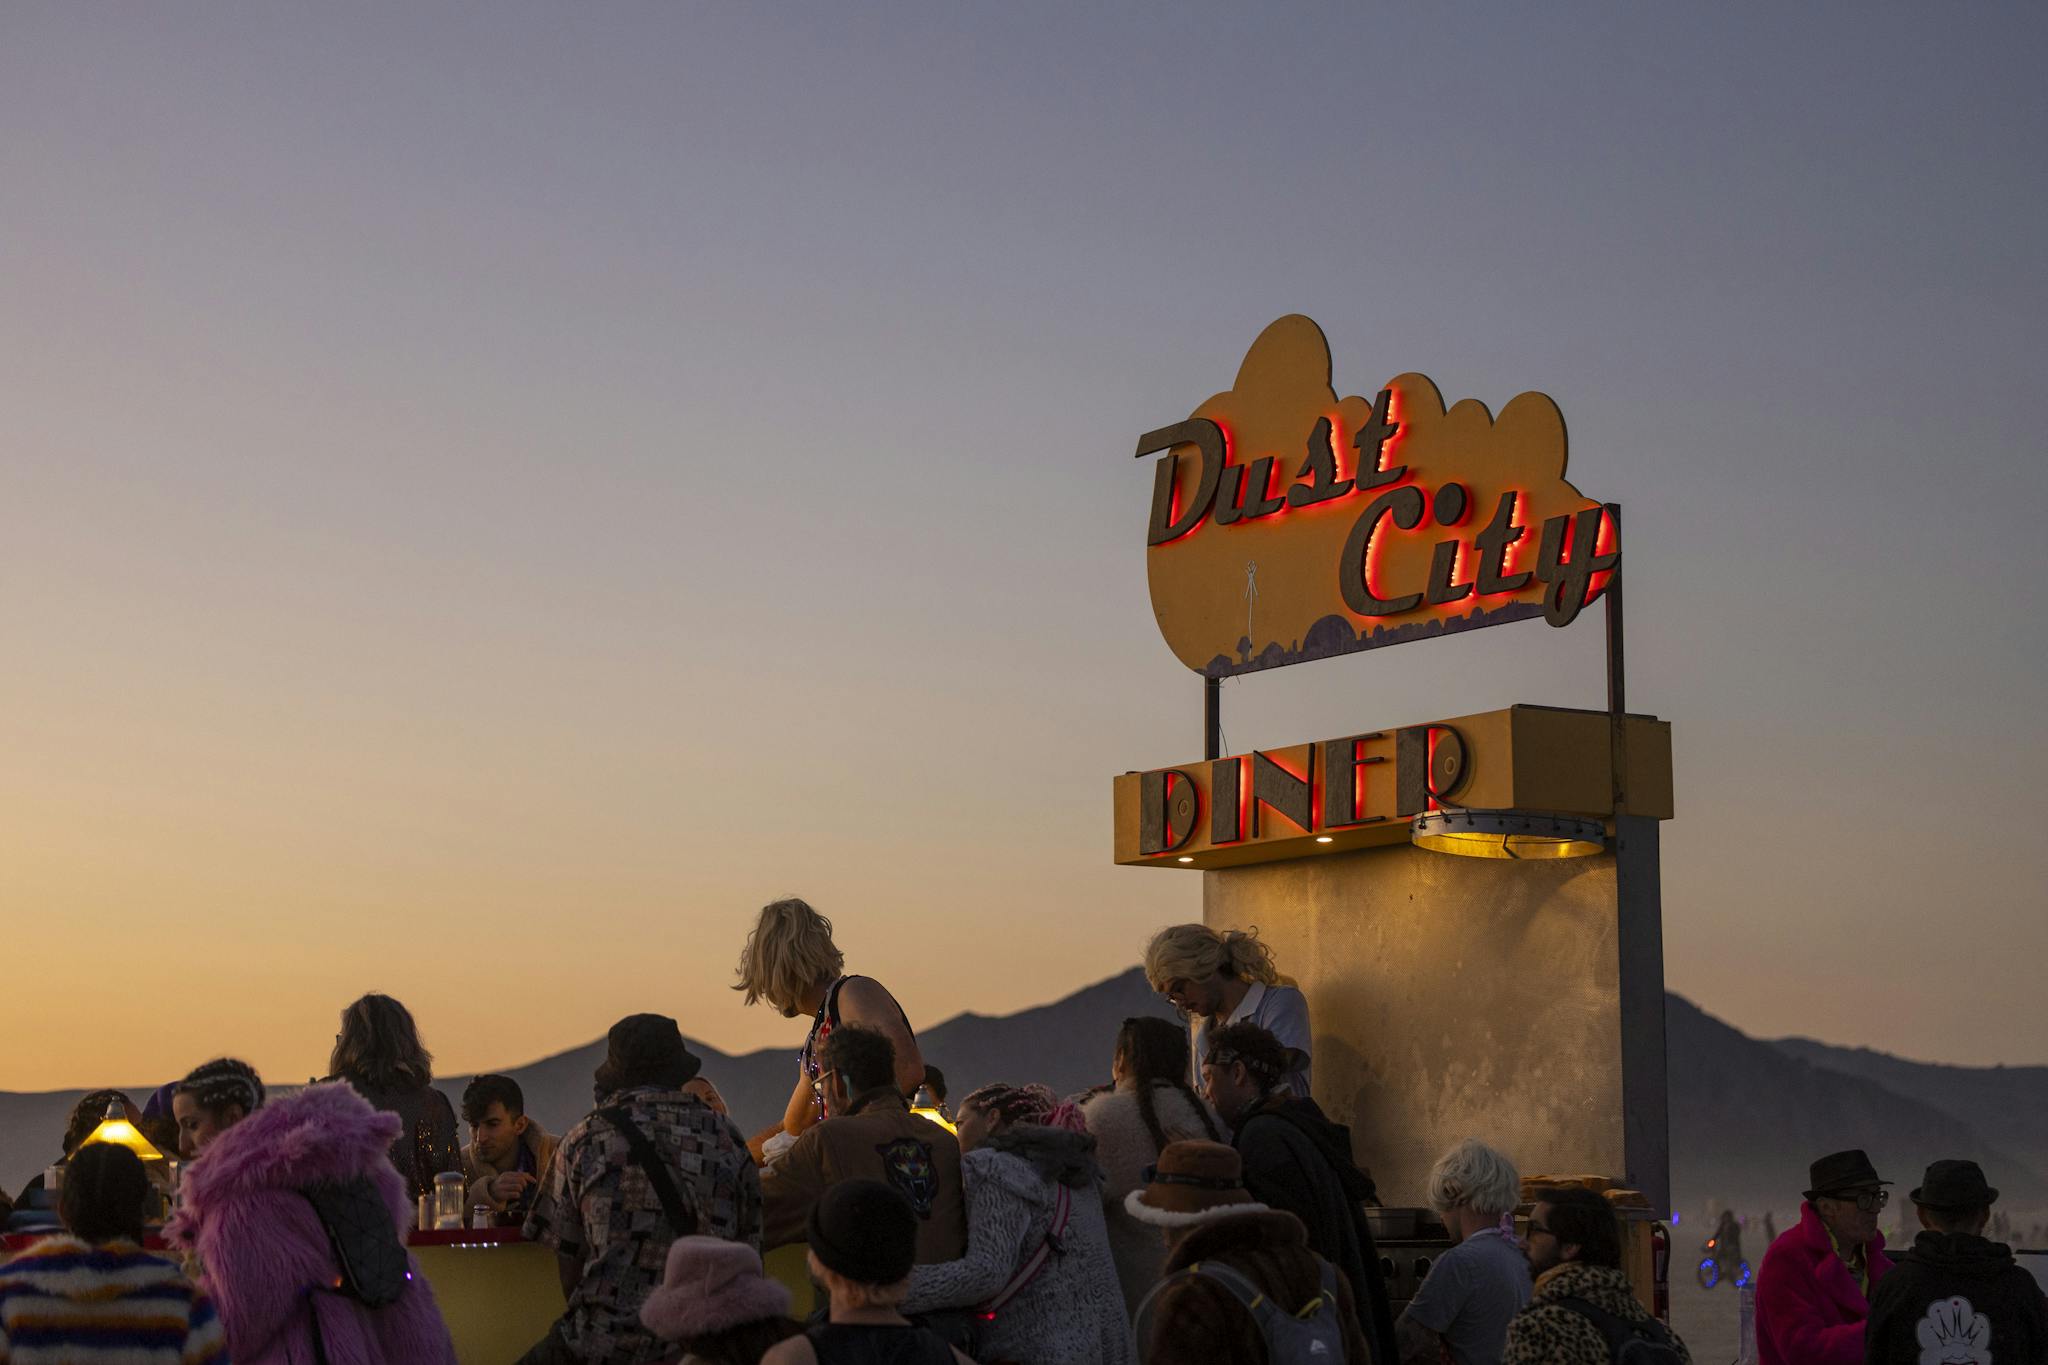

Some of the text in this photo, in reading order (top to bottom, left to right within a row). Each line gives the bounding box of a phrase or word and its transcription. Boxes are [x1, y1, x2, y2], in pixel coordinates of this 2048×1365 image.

[1135, 389, 1408, 547] Dust
[1339, 482, 1622, 628] City
[1139, 723, 1468, 856] DINER
